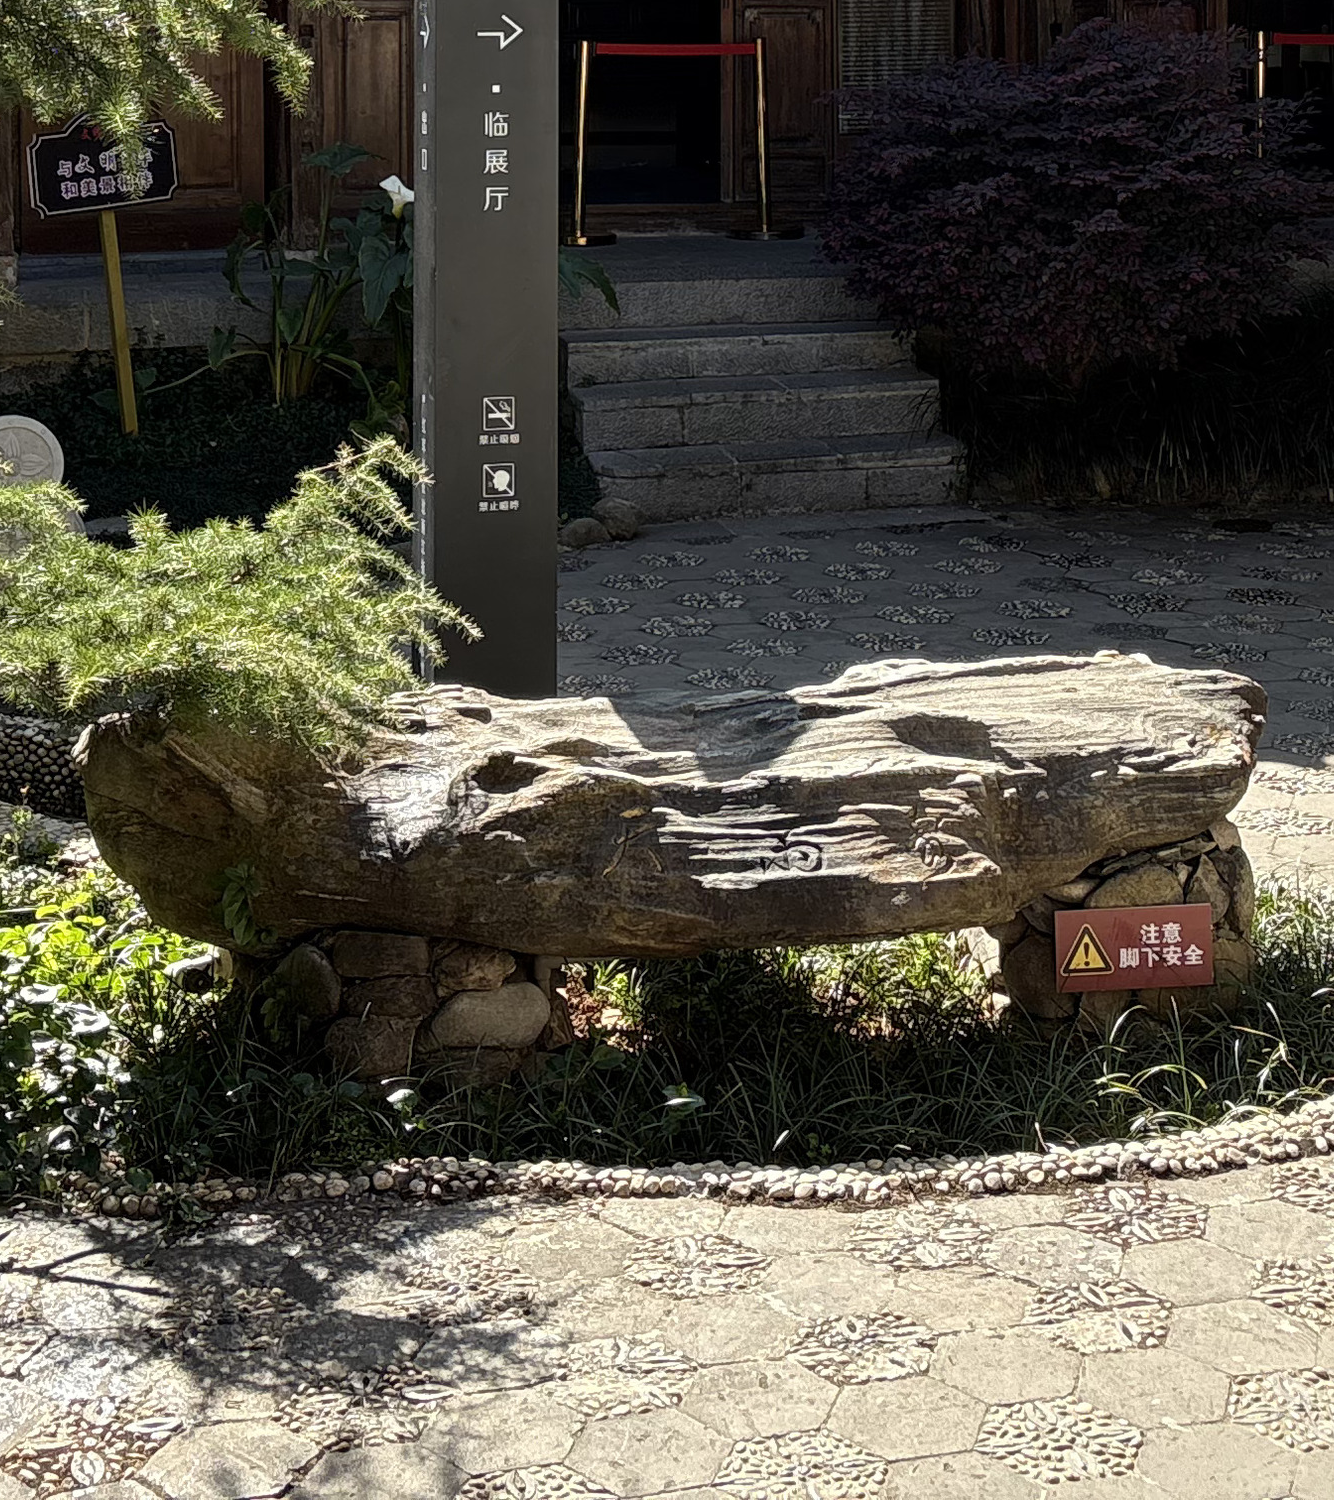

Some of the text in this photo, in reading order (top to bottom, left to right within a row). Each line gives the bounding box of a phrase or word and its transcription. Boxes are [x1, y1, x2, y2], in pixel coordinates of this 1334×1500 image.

[483, 111, 510, 212] 临展厅
[479, 433, 520, 445] 禁止吸烟
[1140, 921, 1183, 945] 注意
[1119, 944, 1205, 969] 脚下安全
